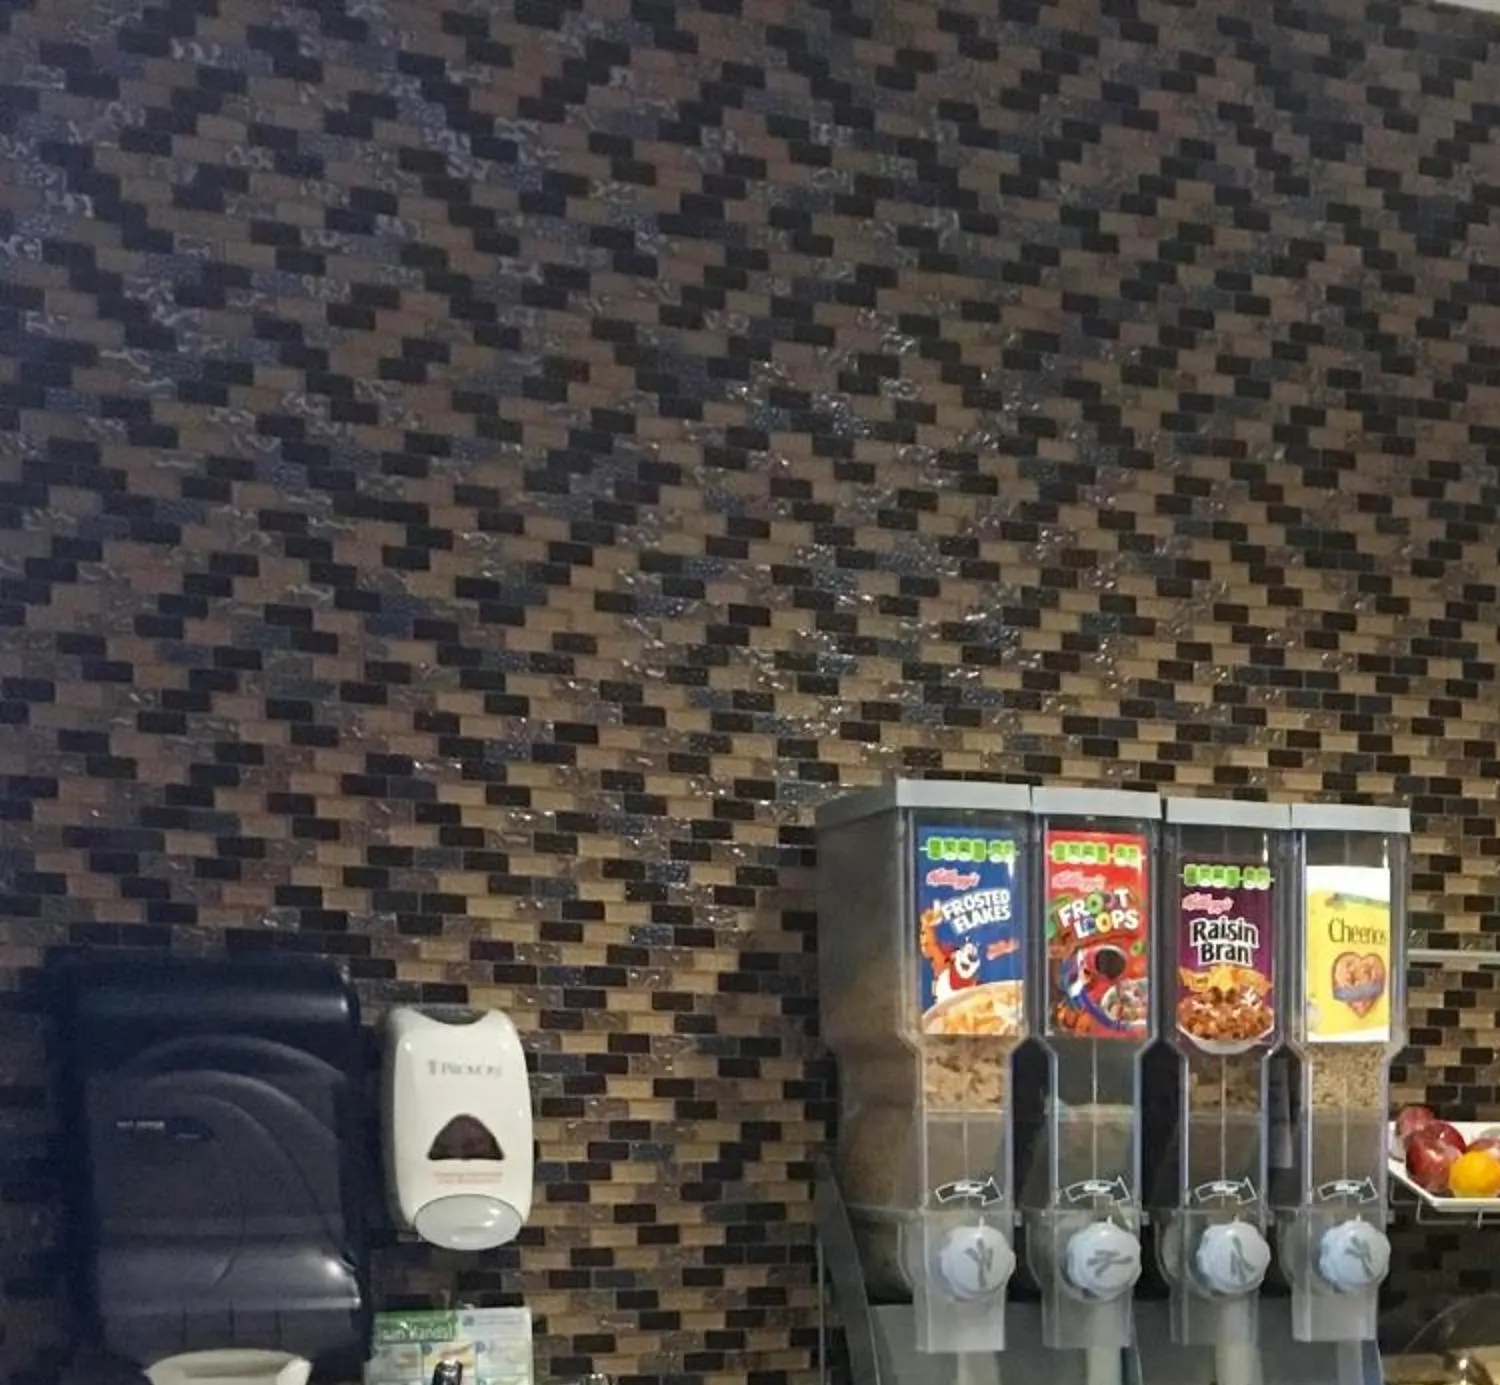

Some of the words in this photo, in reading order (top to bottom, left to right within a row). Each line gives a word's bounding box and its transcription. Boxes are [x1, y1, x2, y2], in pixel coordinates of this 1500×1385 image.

[941, 888, 1011, 920] FROSTED
[1058, 887, 1129, 928] FROOT
[951, 905, 1012, 935] FLAKES
[1073, 908, 1140, 938] LOOPS
[1191, 916, 1258, 945] Raisin
[1200, 941, 1251, 964] Bran
